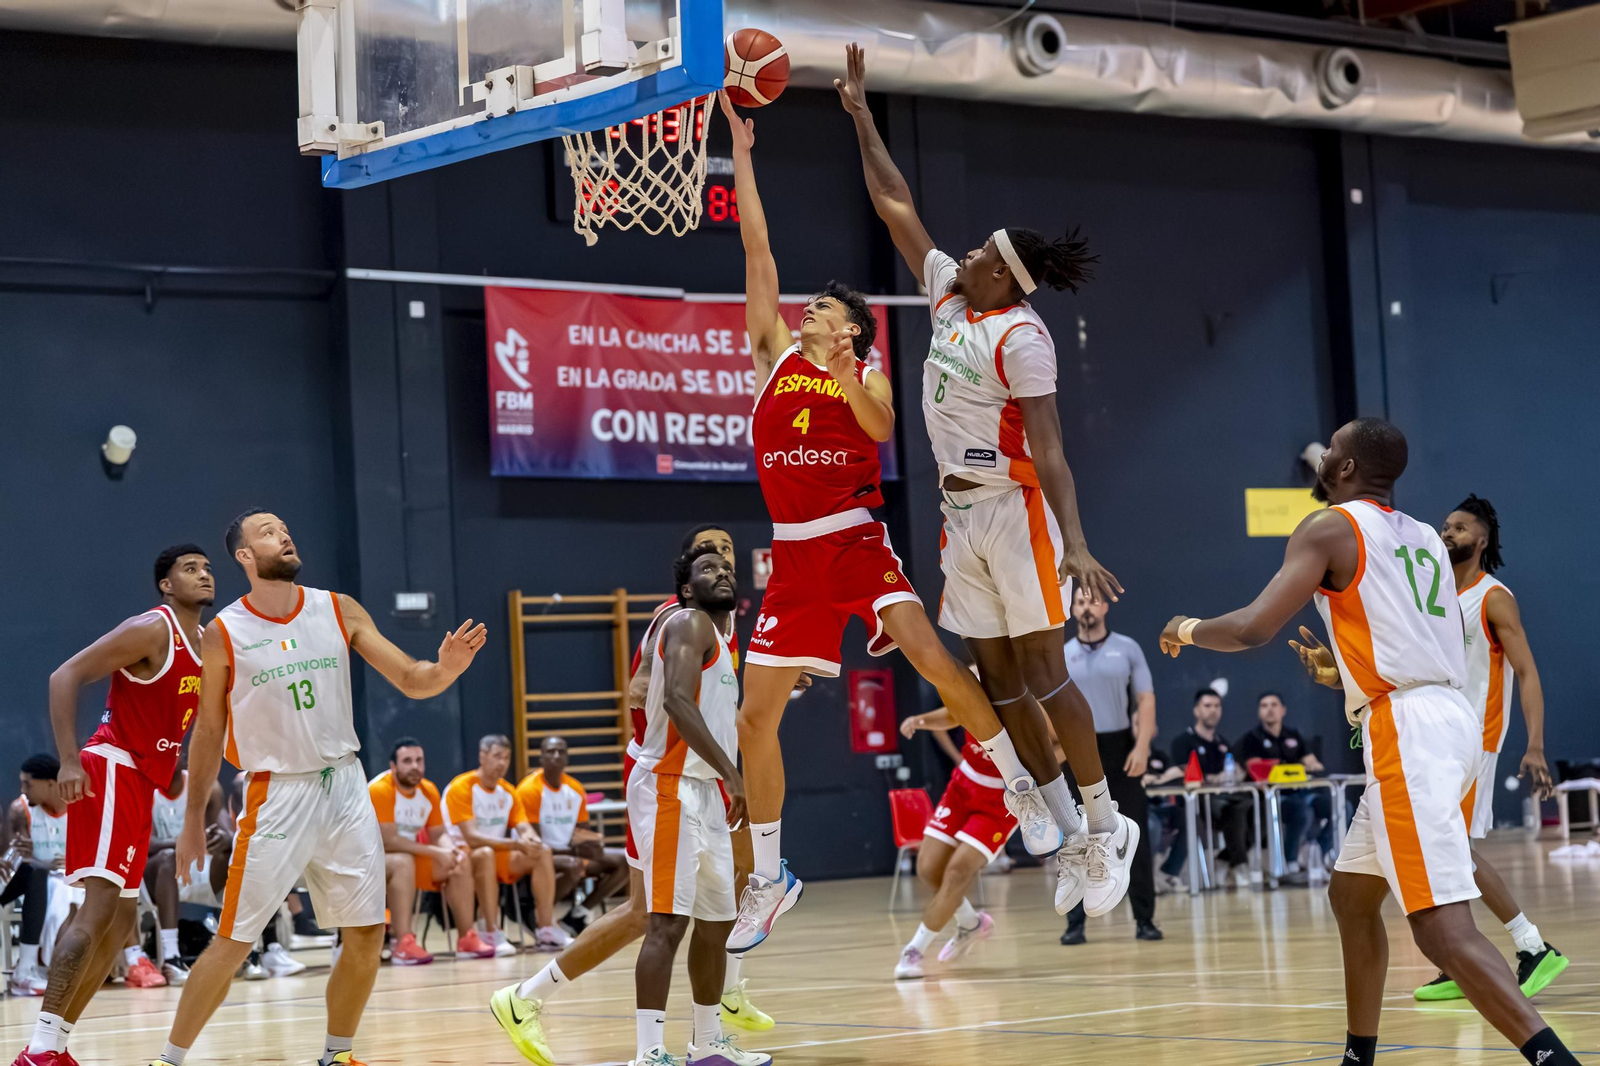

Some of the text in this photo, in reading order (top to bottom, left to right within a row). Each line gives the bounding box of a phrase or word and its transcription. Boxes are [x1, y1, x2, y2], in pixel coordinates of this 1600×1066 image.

[568, 324, 594, 346] EN
[598, 326, 621, 348] LA
[705, 329, 734, 355] SE
[557, 366, 756, 396] EN LA GRADA SE DIS
[934, 372, 949, 404] 6
[496, 390, 534, 410] FBM
[591, 408, 659, 443] CON
[792, 408, 810, 435] 4
[763, 445, 848, 469] endesa
[1394, 545, 1446, 618] 12
[251, 657, 339, 687] CÔTE D'IVOIRE
[287, 679, 316, 711] 13
